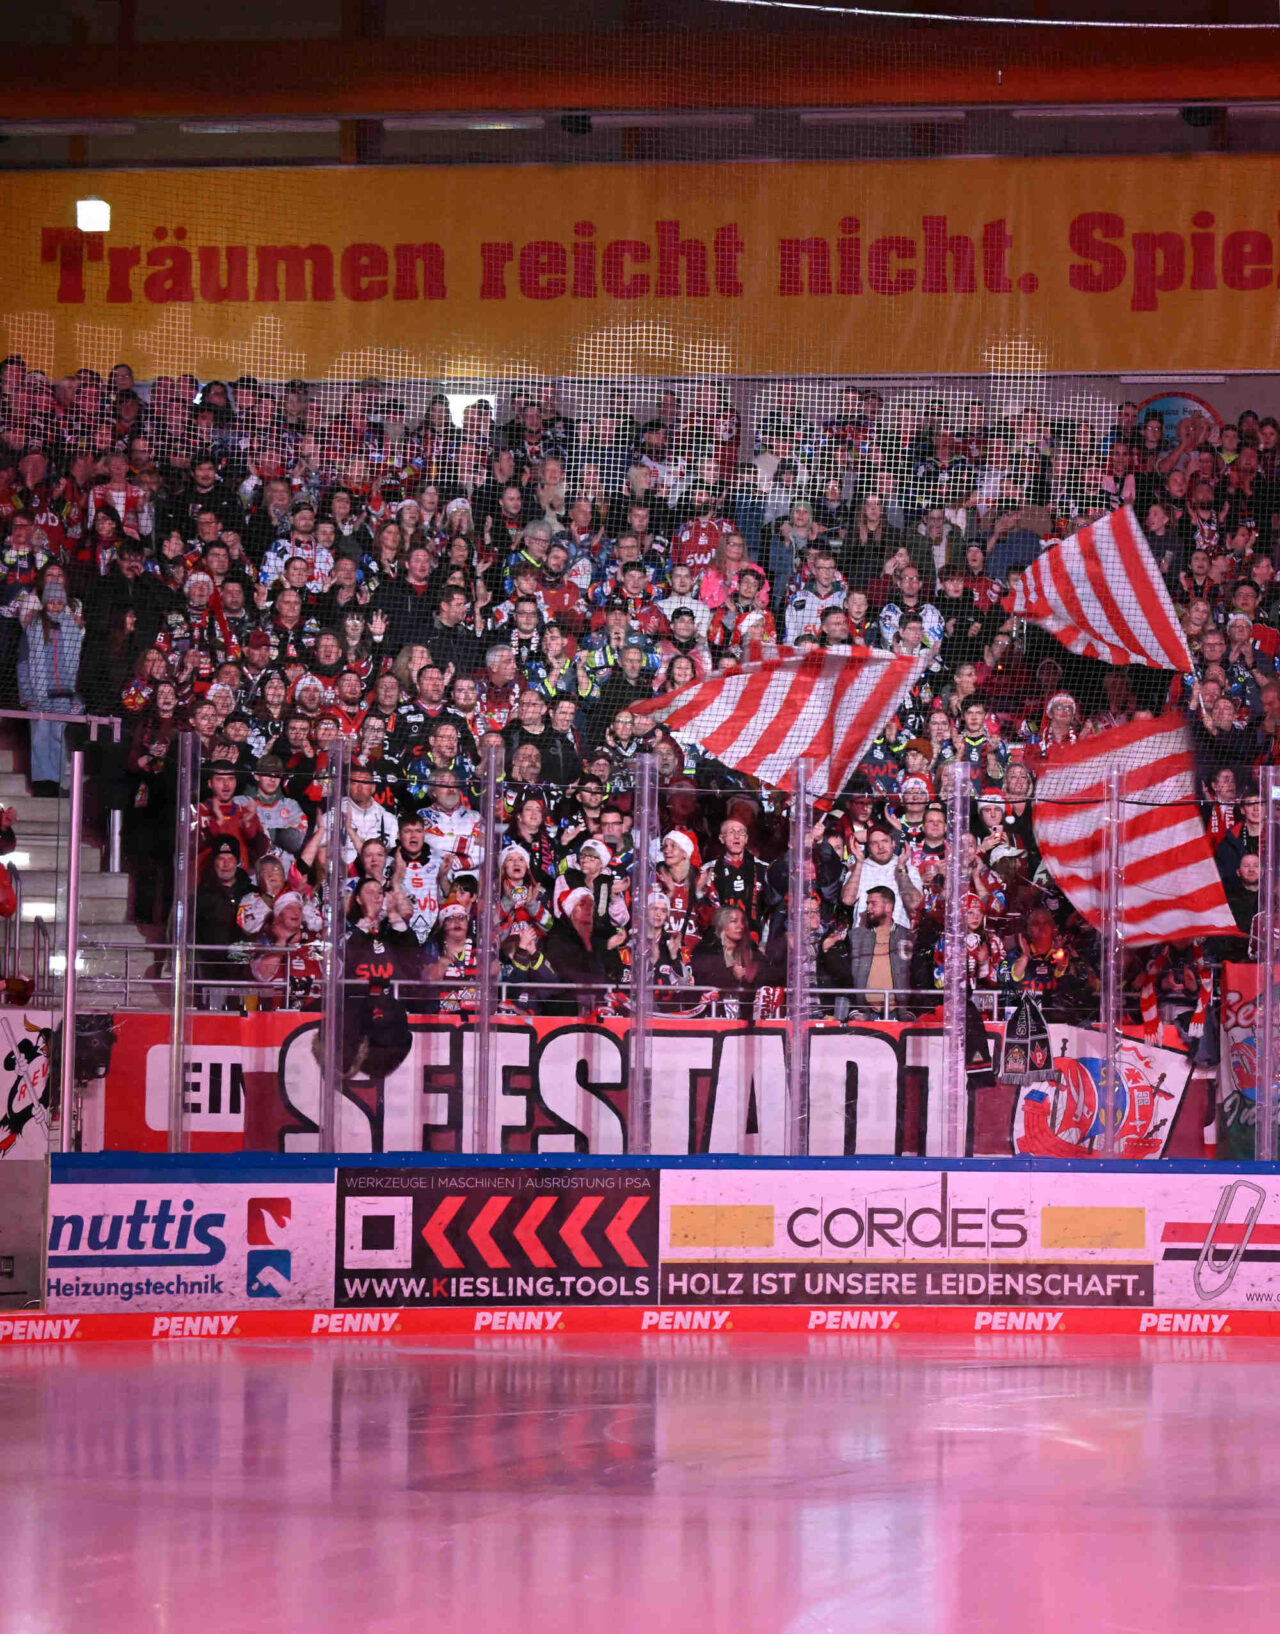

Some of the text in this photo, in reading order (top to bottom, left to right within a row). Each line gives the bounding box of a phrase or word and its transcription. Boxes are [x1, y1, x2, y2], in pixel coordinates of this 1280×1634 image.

[41, 225, 447, 304] Träumen
[480, 219, 744, 300] reicht
[779, 214, 1040, 299] nicht.
[345, 1175, 651, 1189] WERKZEUGE MASCHINEN AUSRÜSTUNG PSA
[48, 1200, 226, 1267] nuttis
[46, 1274, 224, 1301] Heizungstechnik
[344, 1276, 650, 1299] WWW.KIESLING.TOOLS
[668, 1272, 1145, 1297] HOLZ IST UNSERE LEIDENSCHAFT.
